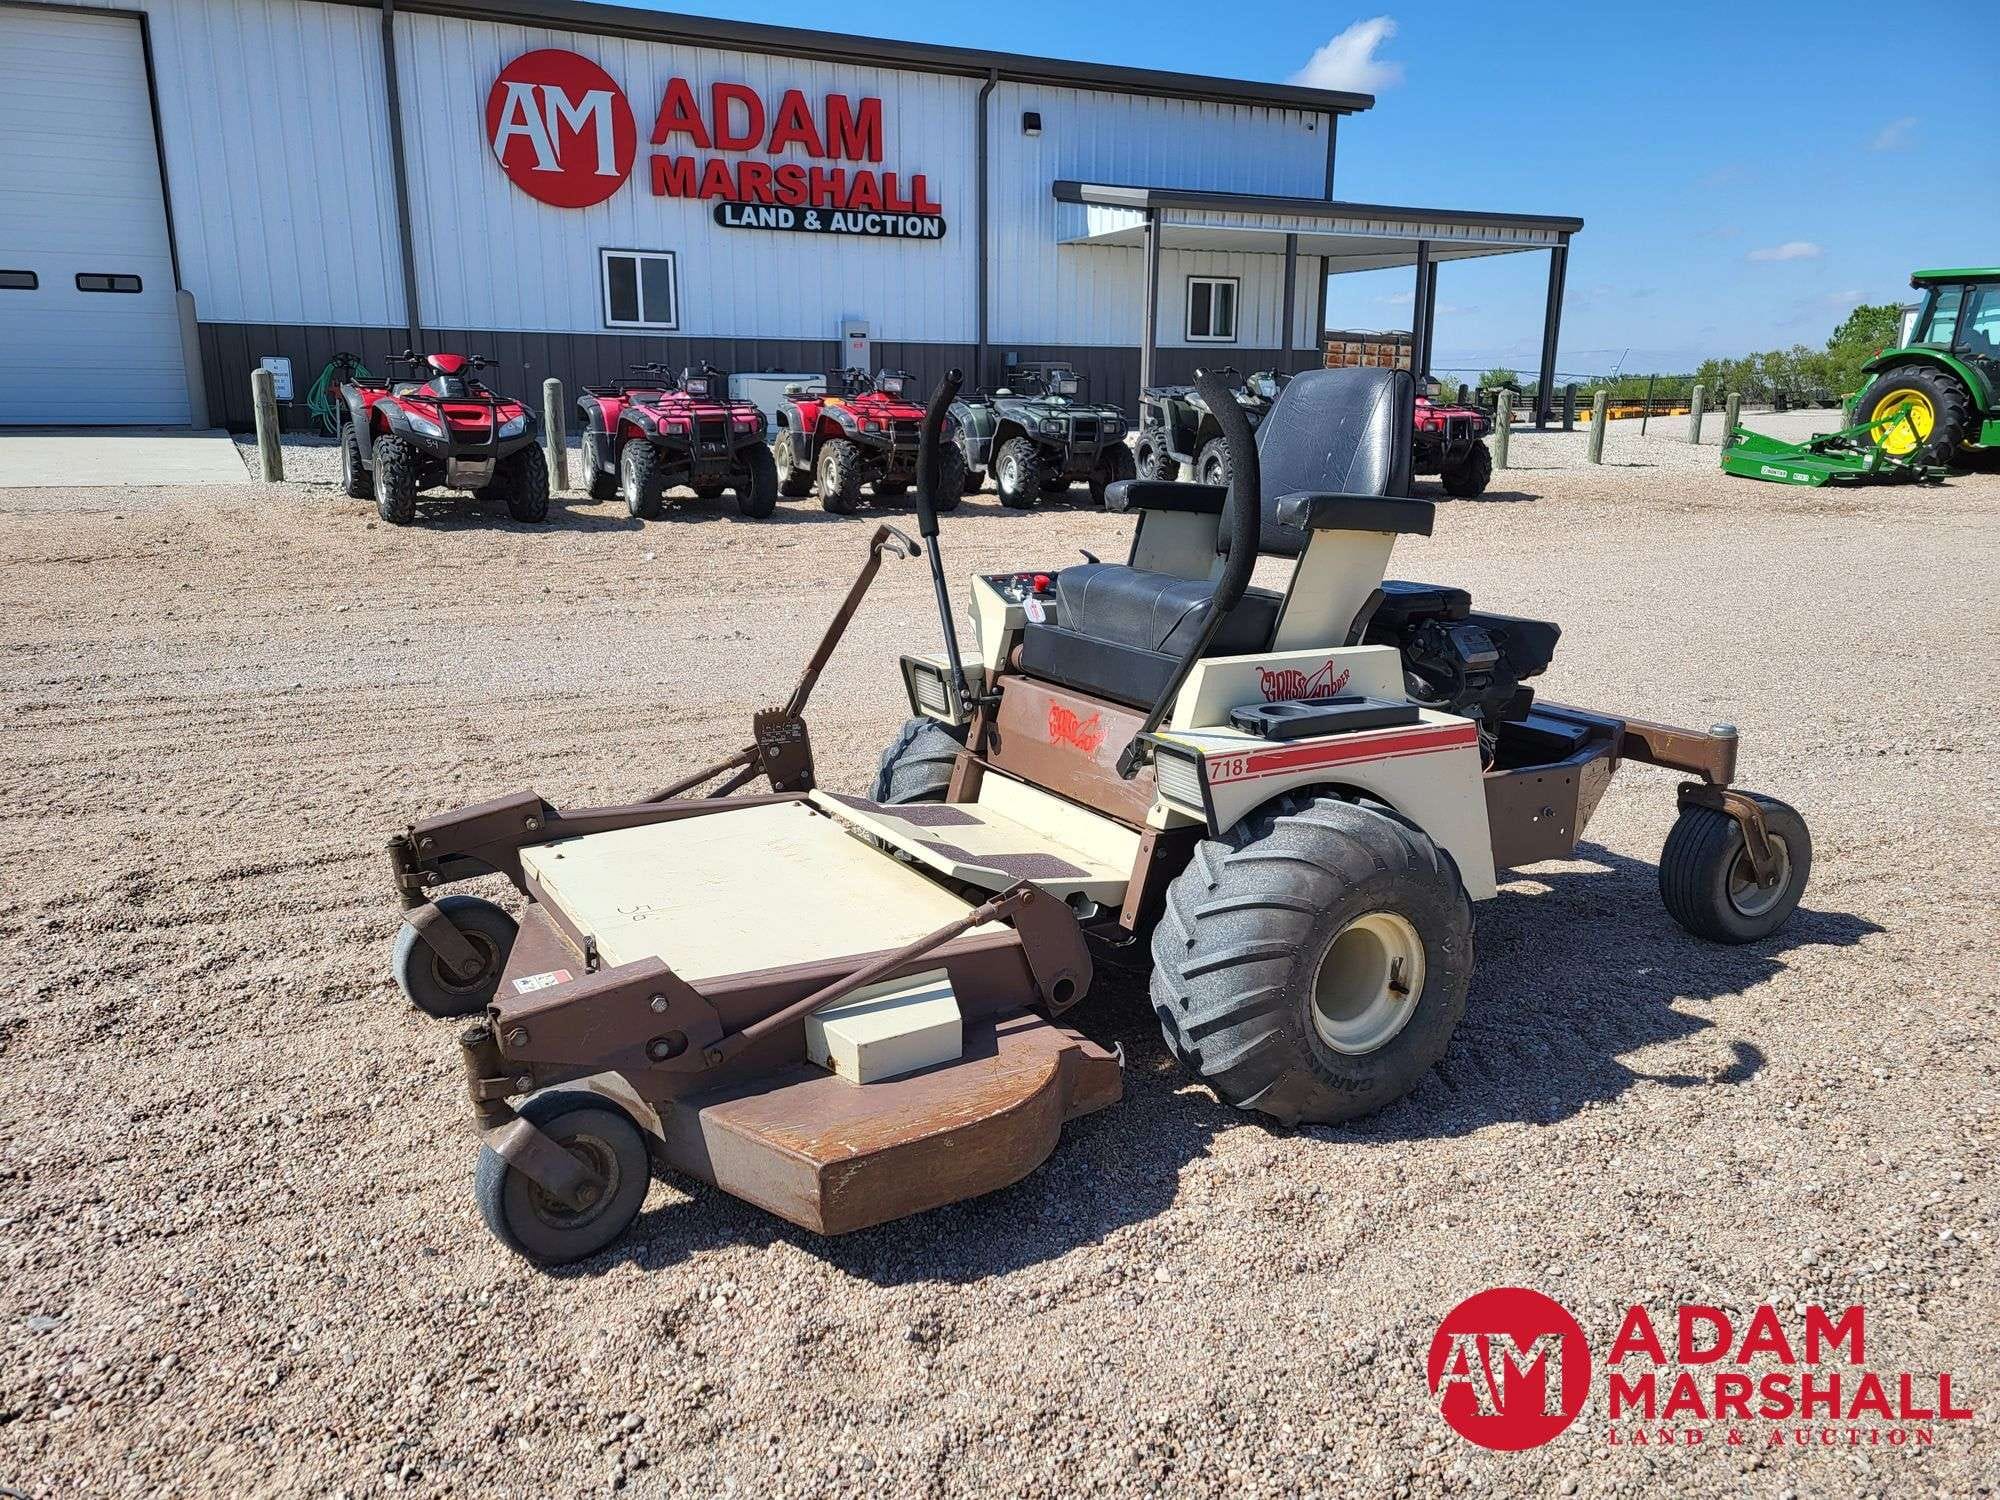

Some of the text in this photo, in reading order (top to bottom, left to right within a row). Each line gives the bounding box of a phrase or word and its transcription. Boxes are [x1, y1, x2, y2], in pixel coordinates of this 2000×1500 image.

[493, 81, 621, 176] AM
[650, 78, 883, 162] ADAM
[650, 154, 942, 214] MARSHALL
[725, 205, 939, 237] LAND & AUCTION
[1210, 759, 1243, 780] 718
